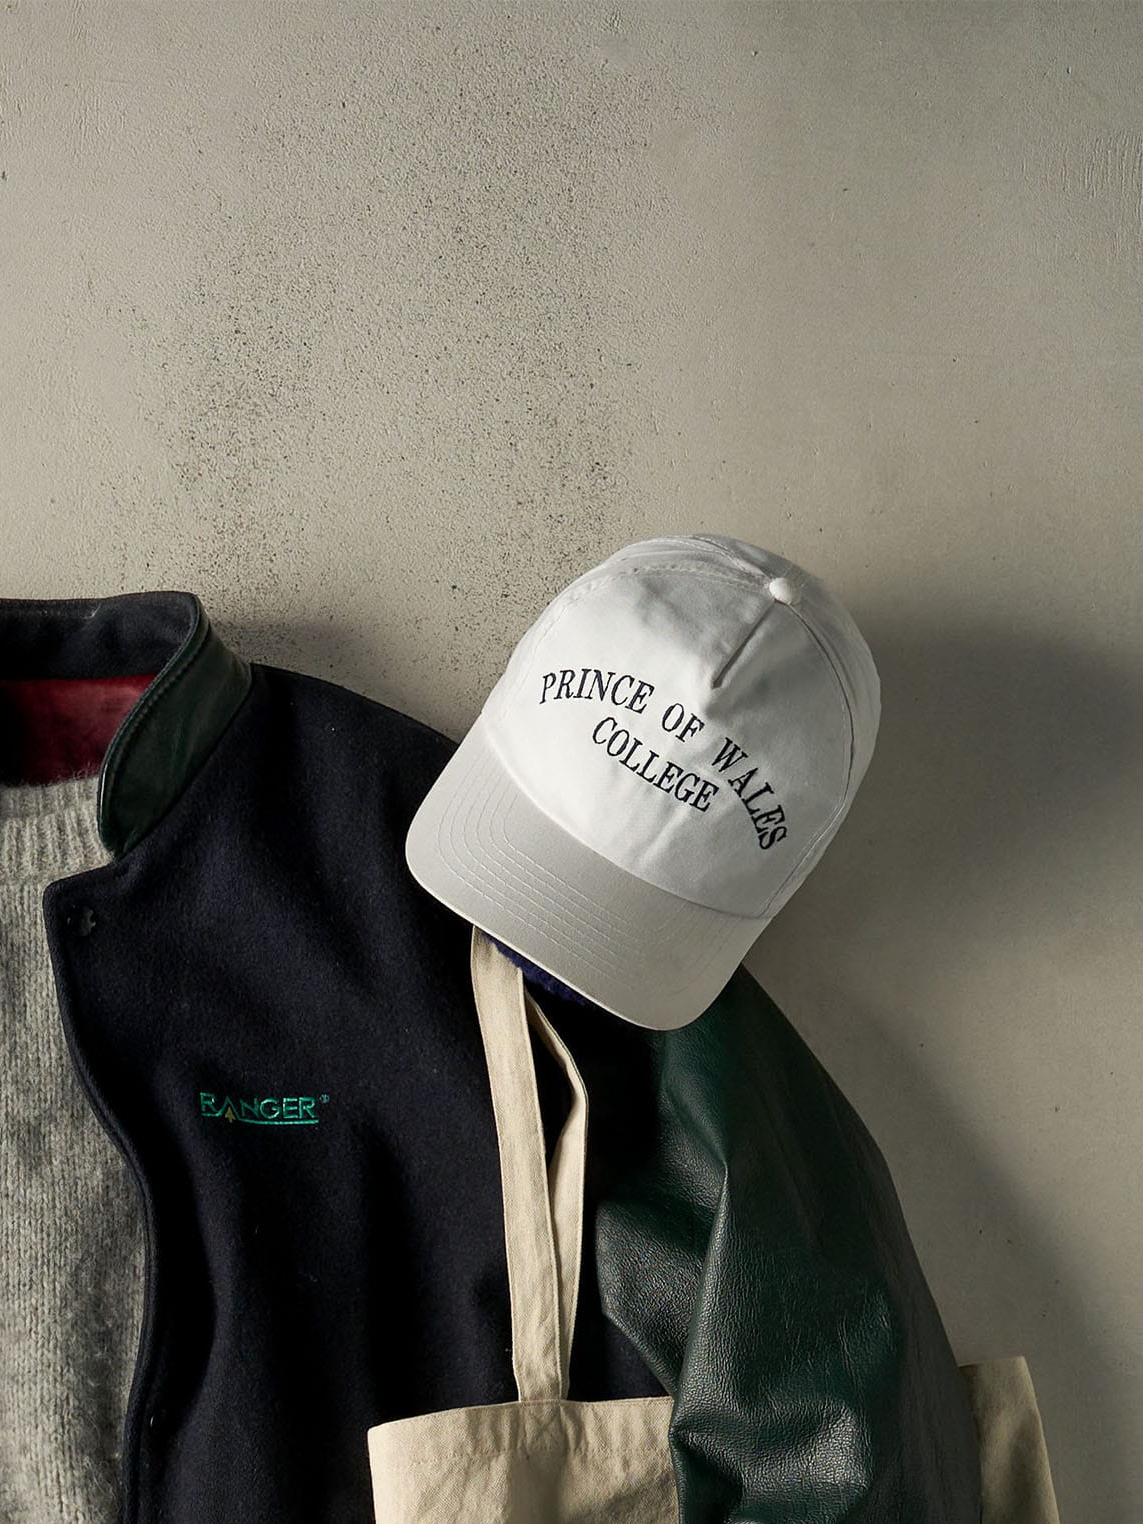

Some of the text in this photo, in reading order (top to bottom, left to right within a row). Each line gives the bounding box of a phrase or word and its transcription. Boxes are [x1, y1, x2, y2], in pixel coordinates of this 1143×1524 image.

[540, 669, 787, 849] PRINCE OF WALES
[592, 717, 719, 812] COLLEGE
